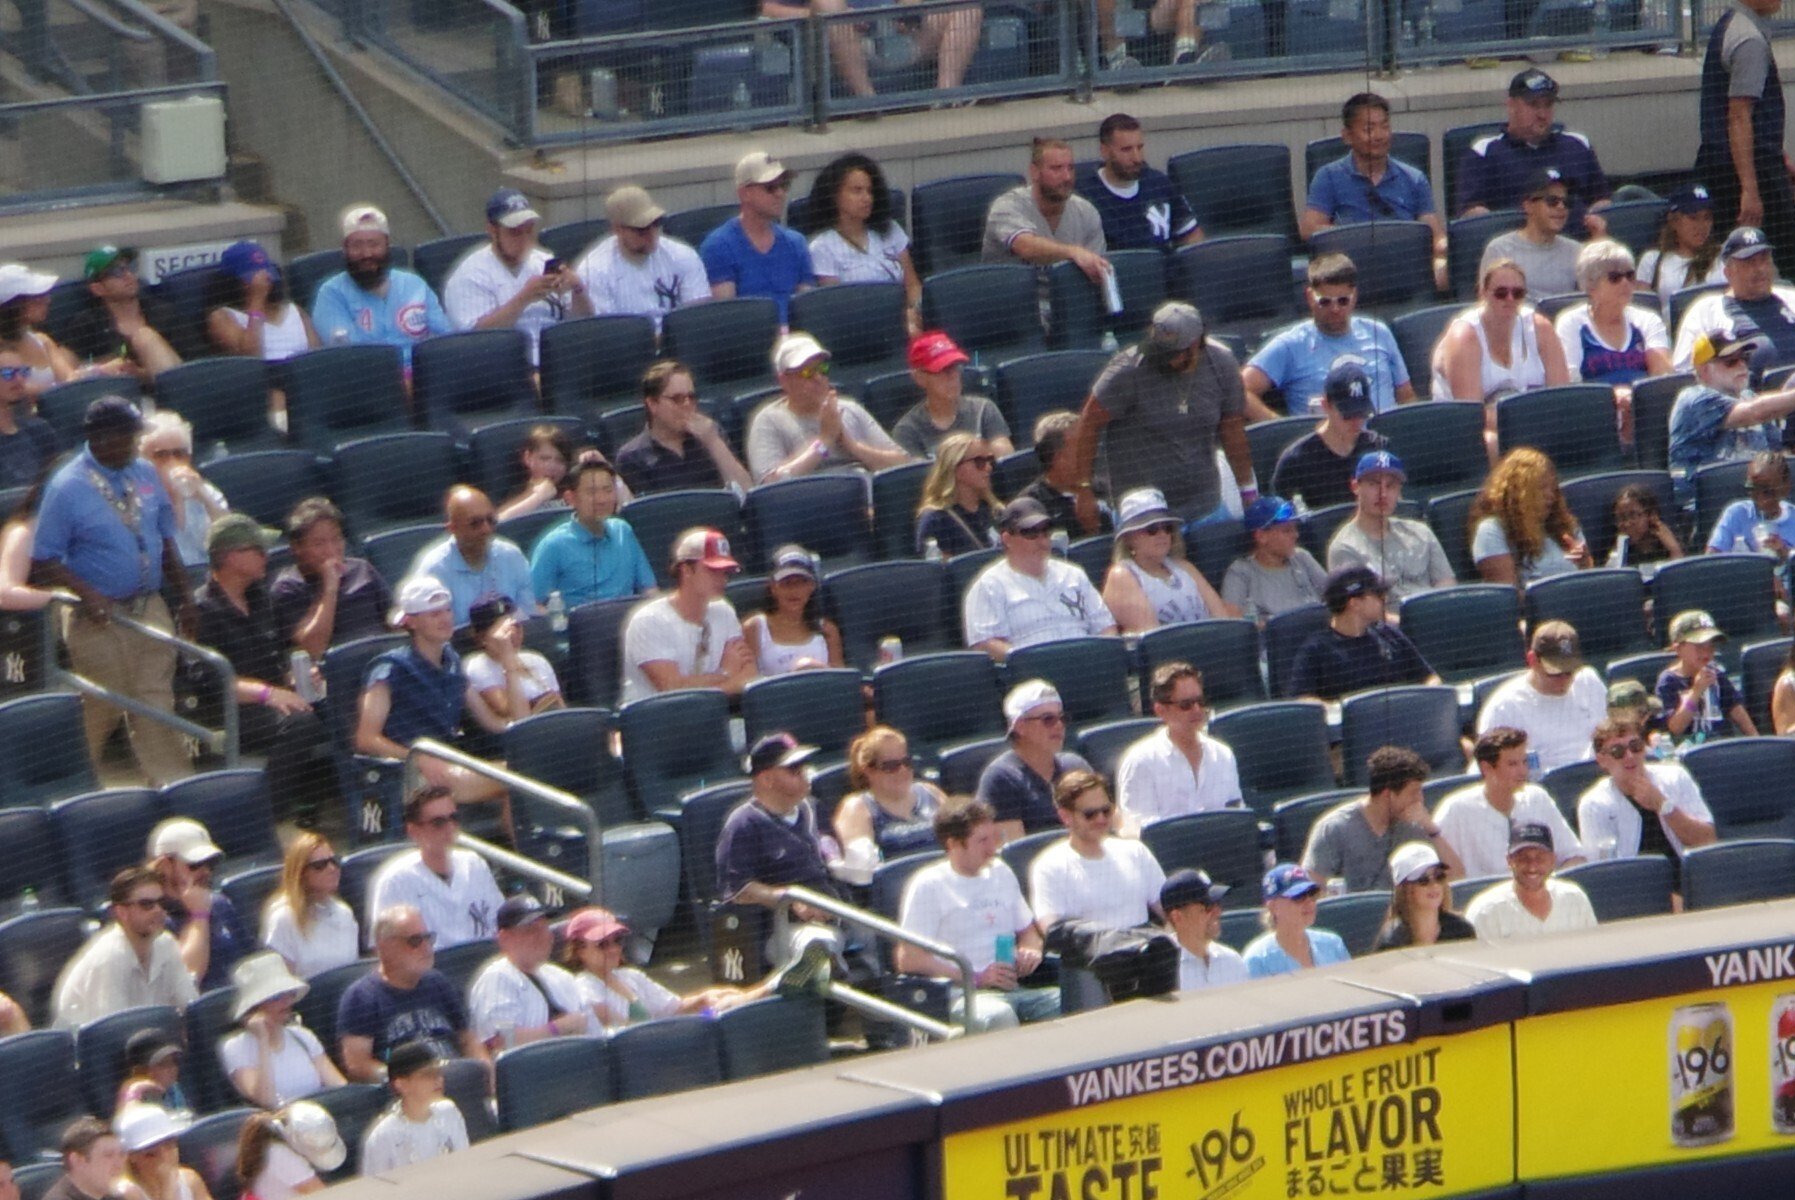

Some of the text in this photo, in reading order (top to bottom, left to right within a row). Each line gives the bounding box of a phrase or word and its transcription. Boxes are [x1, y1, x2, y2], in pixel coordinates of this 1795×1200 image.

[1146, 203, 1170, 241] NY
[655, 276, 682, 310] NY
[1060, 589, 1085, 620] NY
[6, 652, 25, 682] NY
[362, 803, 382, 833] NY
[724, 948, 745, 980] NY
[1066, 1010, 1407, 1106] YANKEES.COM/TICKETS
[1283, 1047, 1441, 1119] WHOLE FRUIT
[1284, 1087, 1443, 1165] FLAVOR
[1004, 1124, 1124, 1176] ULTIMATE
[1285, 1147, 1444, 1198] まるごと果実
